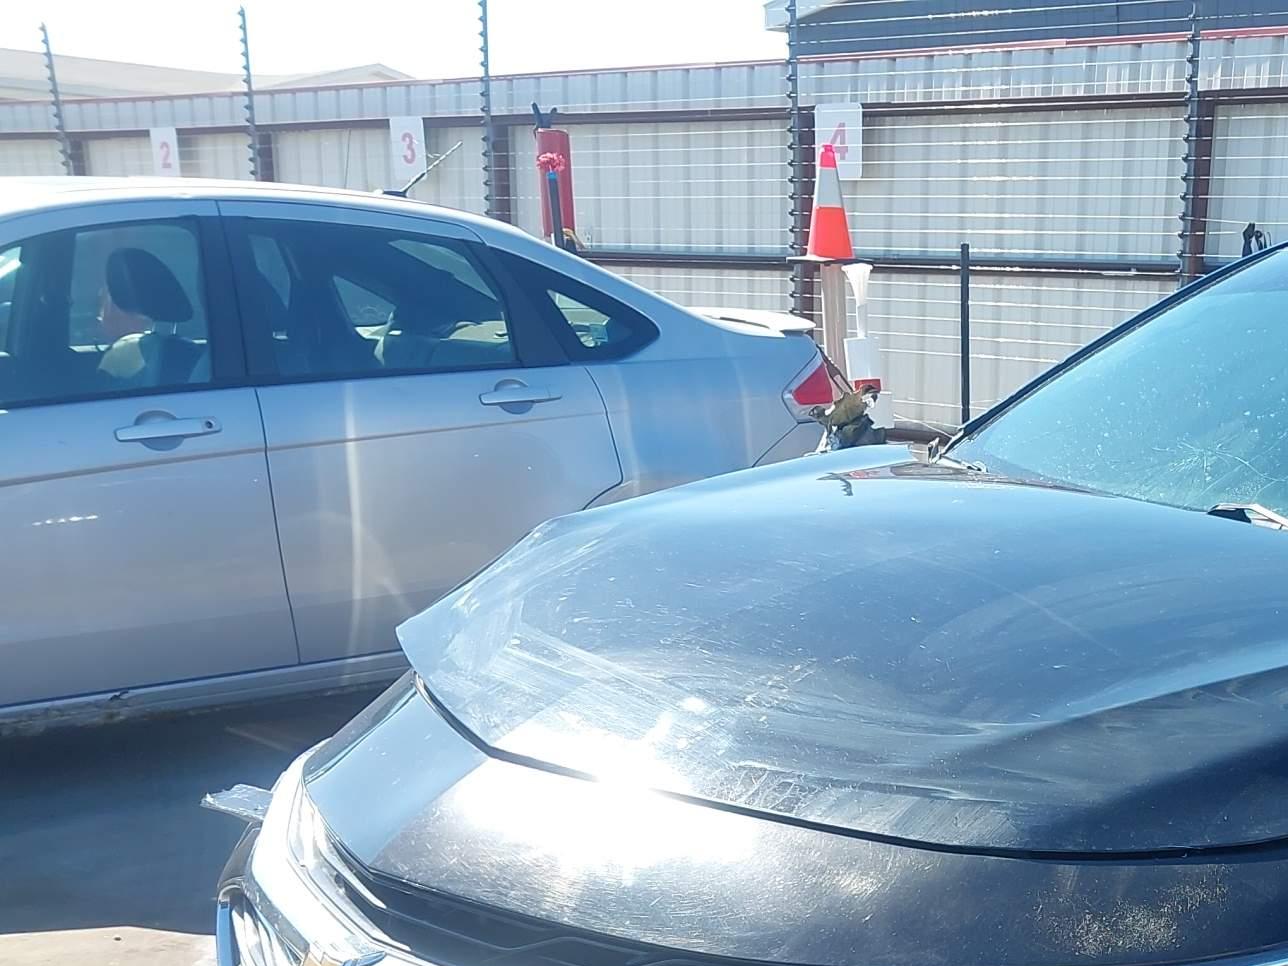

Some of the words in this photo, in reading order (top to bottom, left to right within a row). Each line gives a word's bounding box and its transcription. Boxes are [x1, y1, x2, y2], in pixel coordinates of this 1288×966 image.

[159, 141, 172, 169] 2
[401, 132, 416, 165] 3
[828, 122, 849, 161] 4
